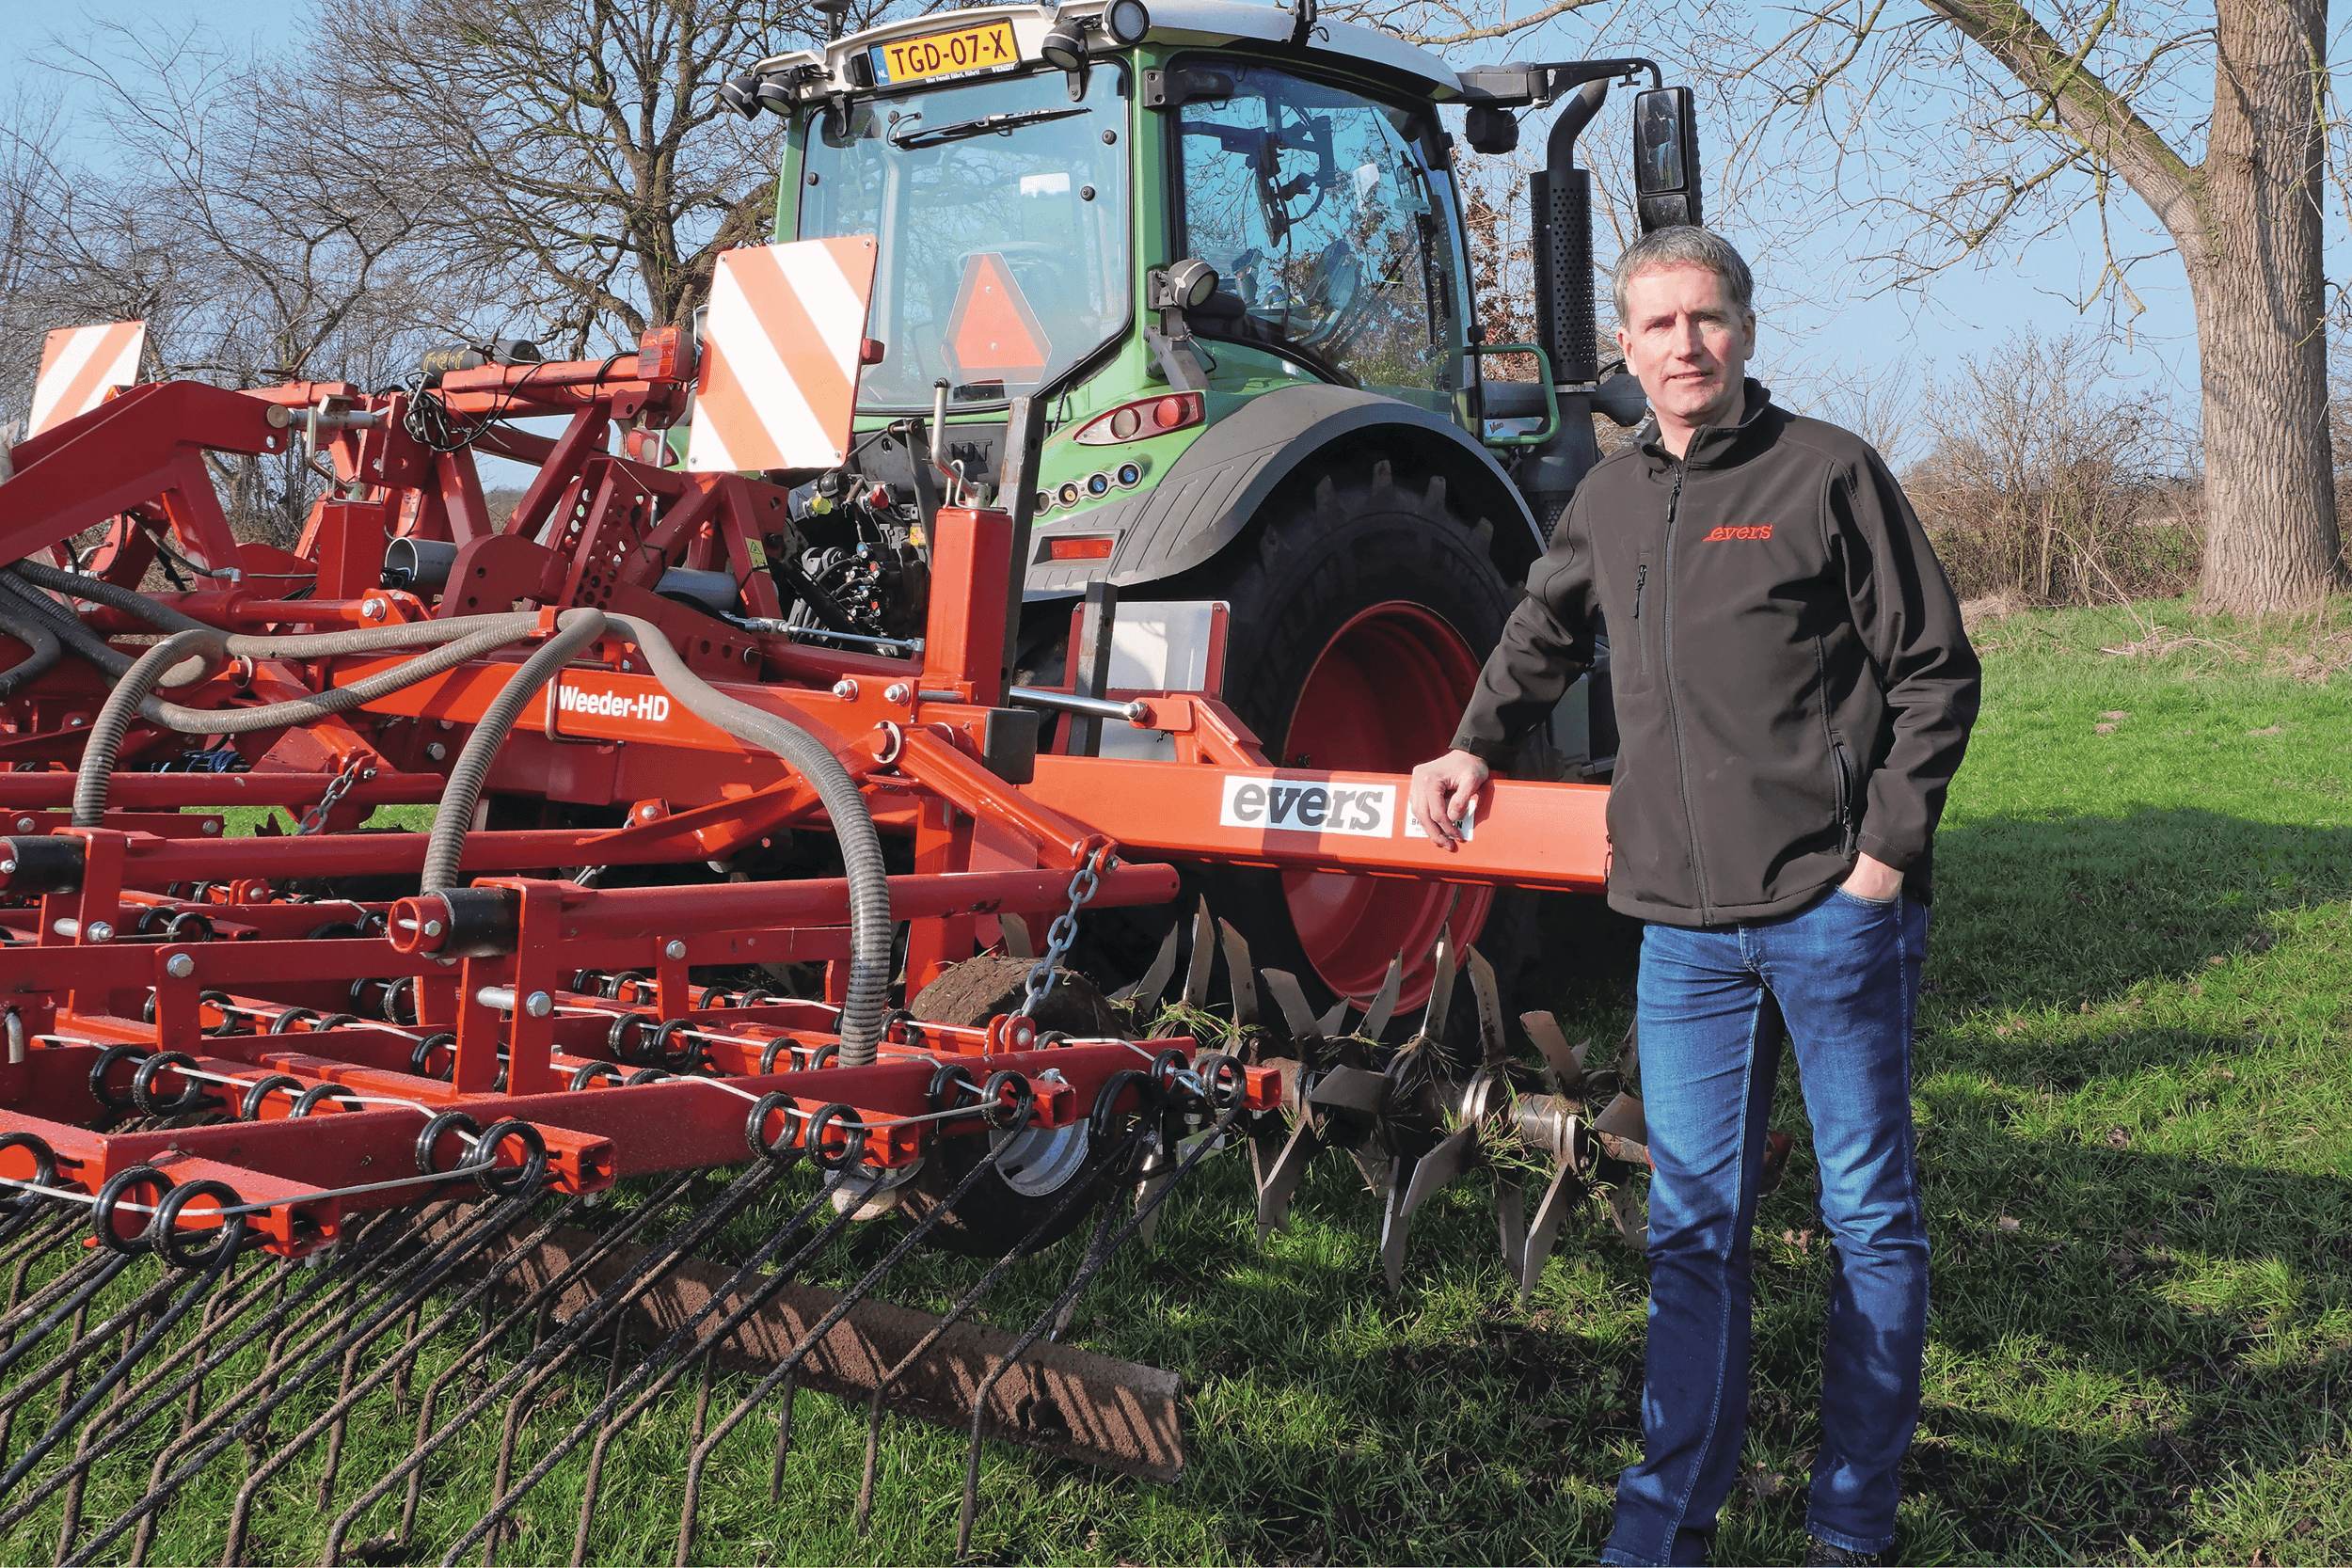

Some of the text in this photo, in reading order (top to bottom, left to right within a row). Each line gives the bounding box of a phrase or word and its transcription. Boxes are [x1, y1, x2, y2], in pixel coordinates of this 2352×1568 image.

[891, 29, 1008, 75] TGD-07-X
[878, 69, 888, 78] NL
[1708, 524, 1773, 540] evers
[559, 685, 669, 721] Weeder-HD
[1233, 783, 1384, 831] evers
